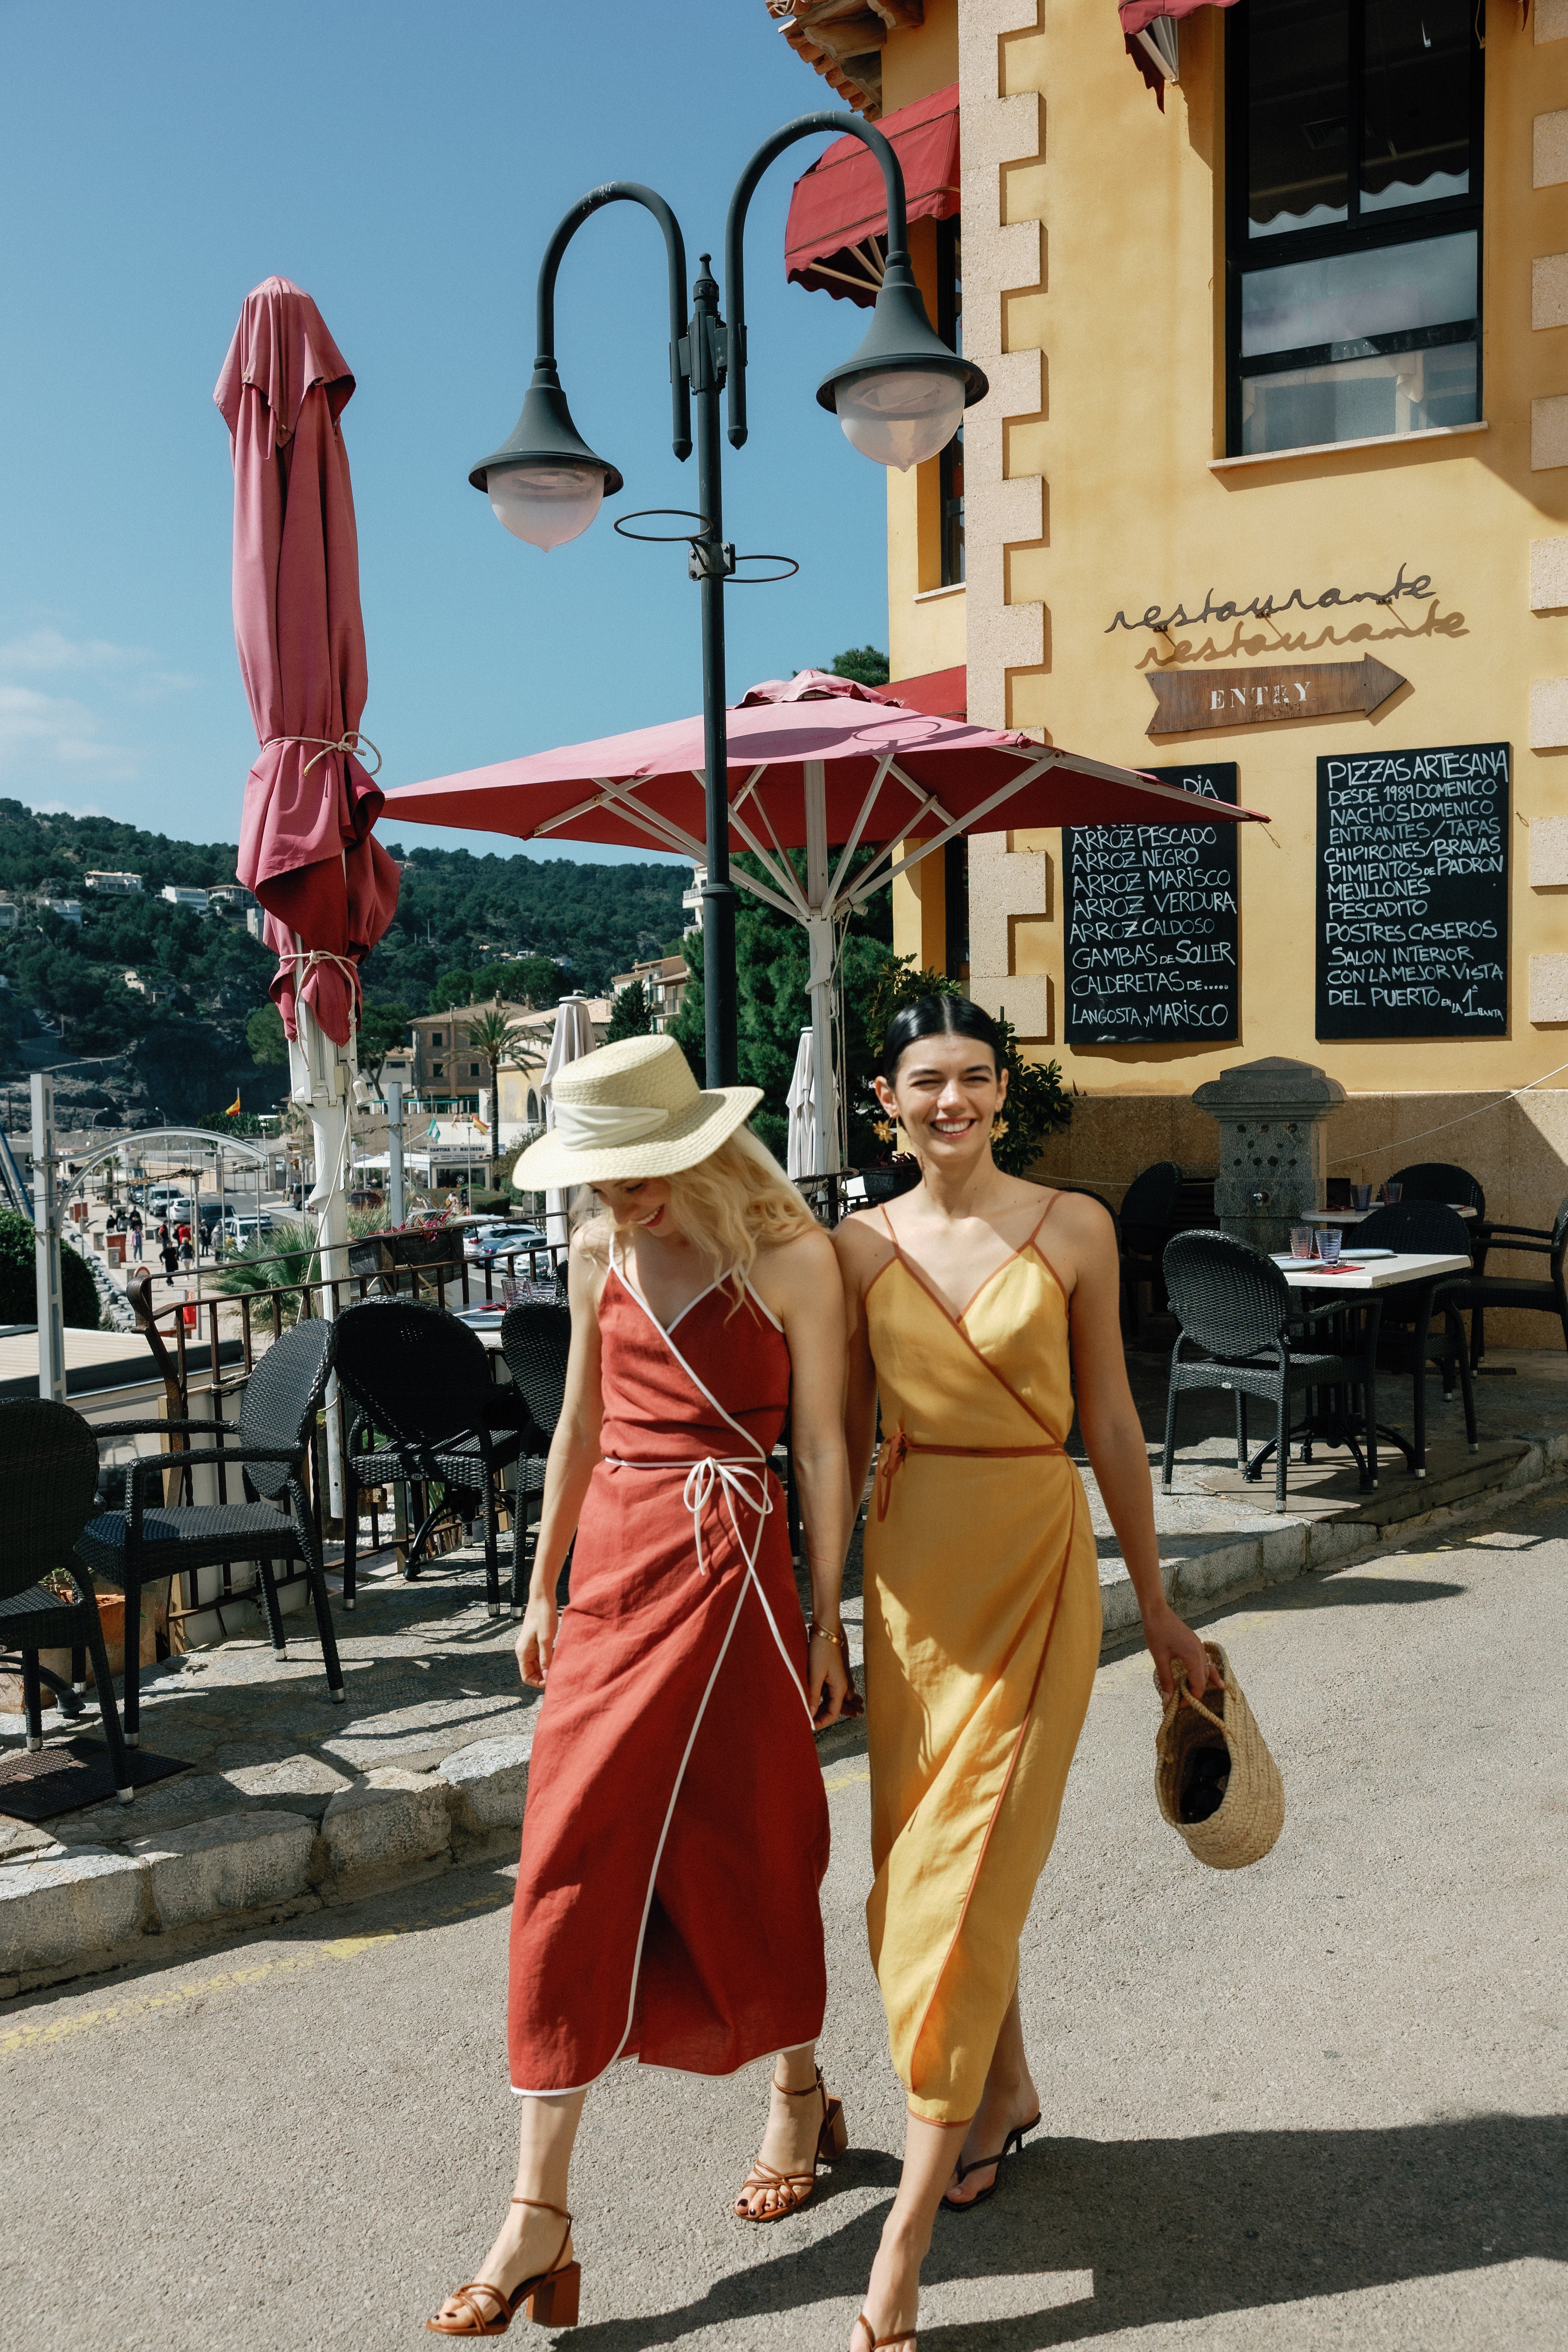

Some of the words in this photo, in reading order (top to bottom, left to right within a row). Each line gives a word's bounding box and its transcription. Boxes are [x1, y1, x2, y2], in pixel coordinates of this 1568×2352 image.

[1104, 563, 1436, 633] restaurante
[1210, 682, 1311, 709] ENTRY
[1328, 758, 1411, 787] PIZZAS
[1413, 750, 1508, 782] ARTESANA
[1328, 787, 1379, 806] DESDE
[1384, 785, 1414, 801] 1989
[1416, 778, 1496, 799] DOMENICO
[1331, 804, 1410, 826] NACHOS
[1411, 800, 1493, 818] DOMENICO
[1072, 830, 1135, 852] ARROZ
[1138, 827, 1216, 847] PESCADO
[1330, 822, 1430, 845] ENTRANTES
[1072, 852, 1143, 873] ARROZ
[1143, 847, 1199, 867] NEGRO
[1329, 861, 1422, 881] PIMIENTOS
[1437, 855, 1503, 876] PADRON
[1073, 873, 1144, 897] ARROZ
[1328, 878, 1430, 900] MEJILLONES
[1073, 896, 1145, 920] ARROZ
[1153, 891, 1237, 914] VERDURA
[1329, 899, 1427, 919] PESCADITO
[1070, 921, 1142, 944] ARROZ
[1142, 918, 1214, 935] CALDOSO
[1326, 922, 1406, 943] POSTRES
[1409, 920, 1497, 940] CASEROS
[1073, 943, 1157, 969] GAMBAS
[1176, 940, 1235, 965] SOLLER
[1328, 947, 1385, 965] SALON
[1393, 945, 1473, 964] INTERIOR
[1072, 971, 1184, 995] CALDERETAS
[1327, 970, 1364, 984] CON
[1369, 969, 1391, 983] LA
[1392, 965, 1450, 981] MEJOR
[1329, 989, 1366, 1005] DEL
[1371, 986, 1440, 1006] PUERTO
[1072, 1004, 1142, 1025] LANGOSTA
